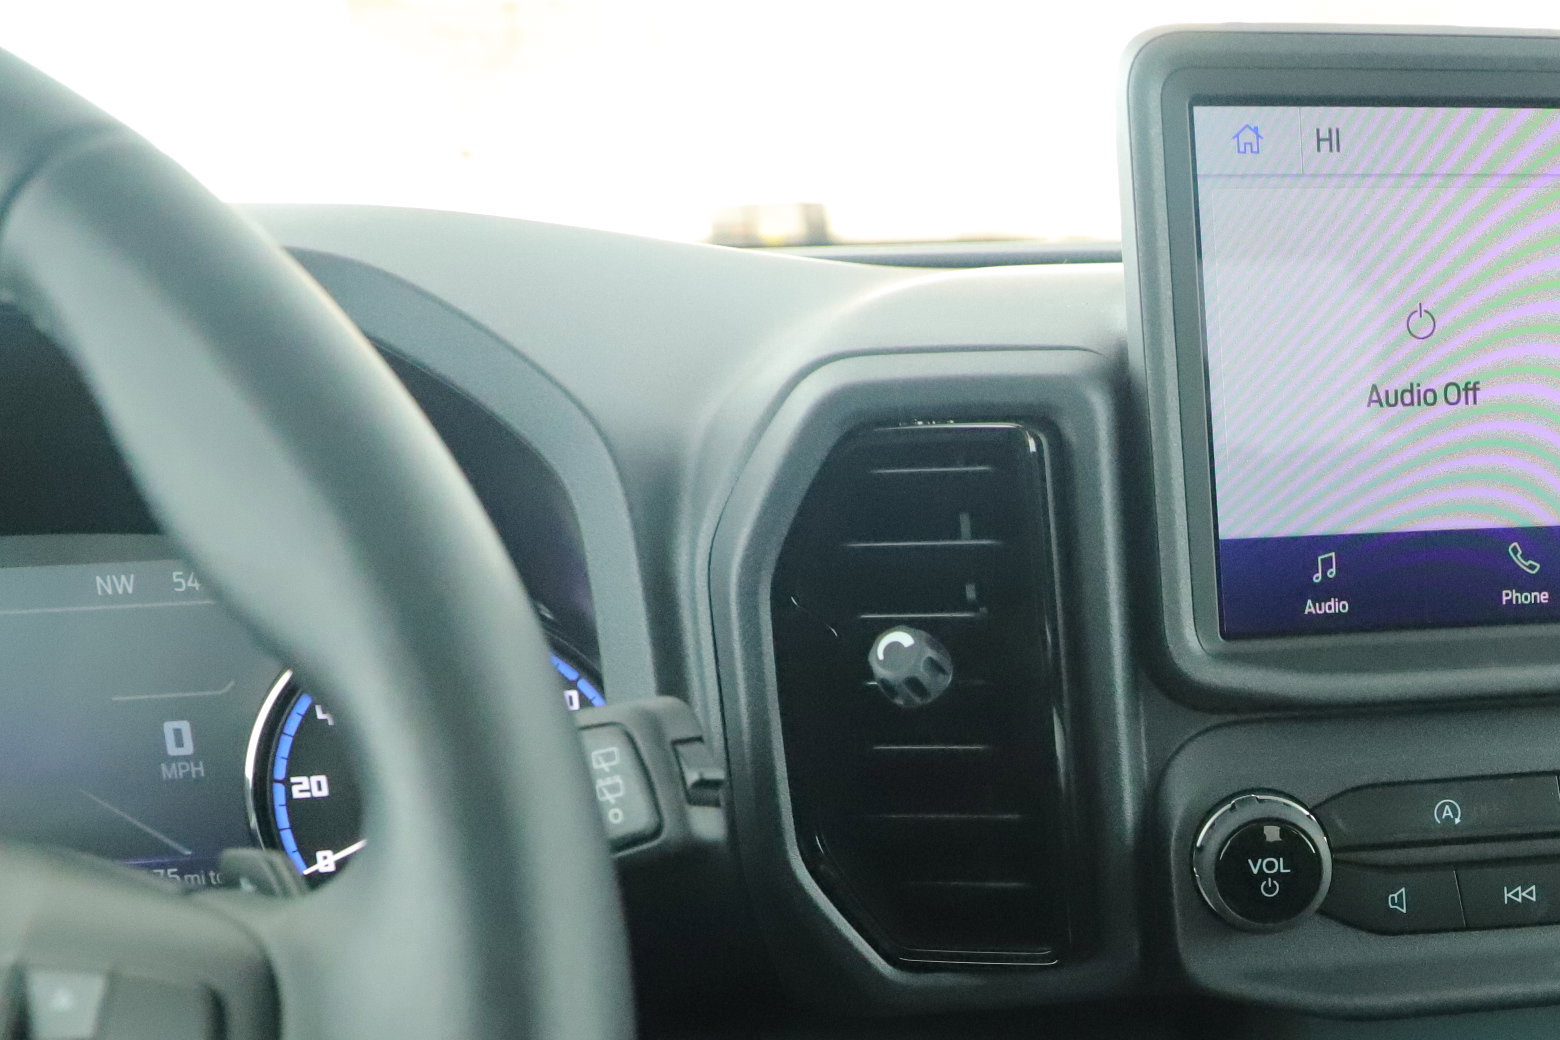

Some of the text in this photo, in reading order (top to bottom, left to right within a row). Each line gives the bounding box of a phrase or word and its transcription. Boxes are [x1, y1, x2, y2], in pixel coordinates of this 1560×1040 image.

[1316, 127, 1340, 153] HI
[1366, 381, 1481, 408] Audio Off
[95, 574, 135, 596] NW
[1304, 597, 1349, 615] Audio
[1502, 589, 1550, 605] Phone
[163, 720, 194, 756] 0
[161, 761, 205, 781] MPH
[290, 774, 330, 799] 20
[1247, 857, 1291, 875] VOL
